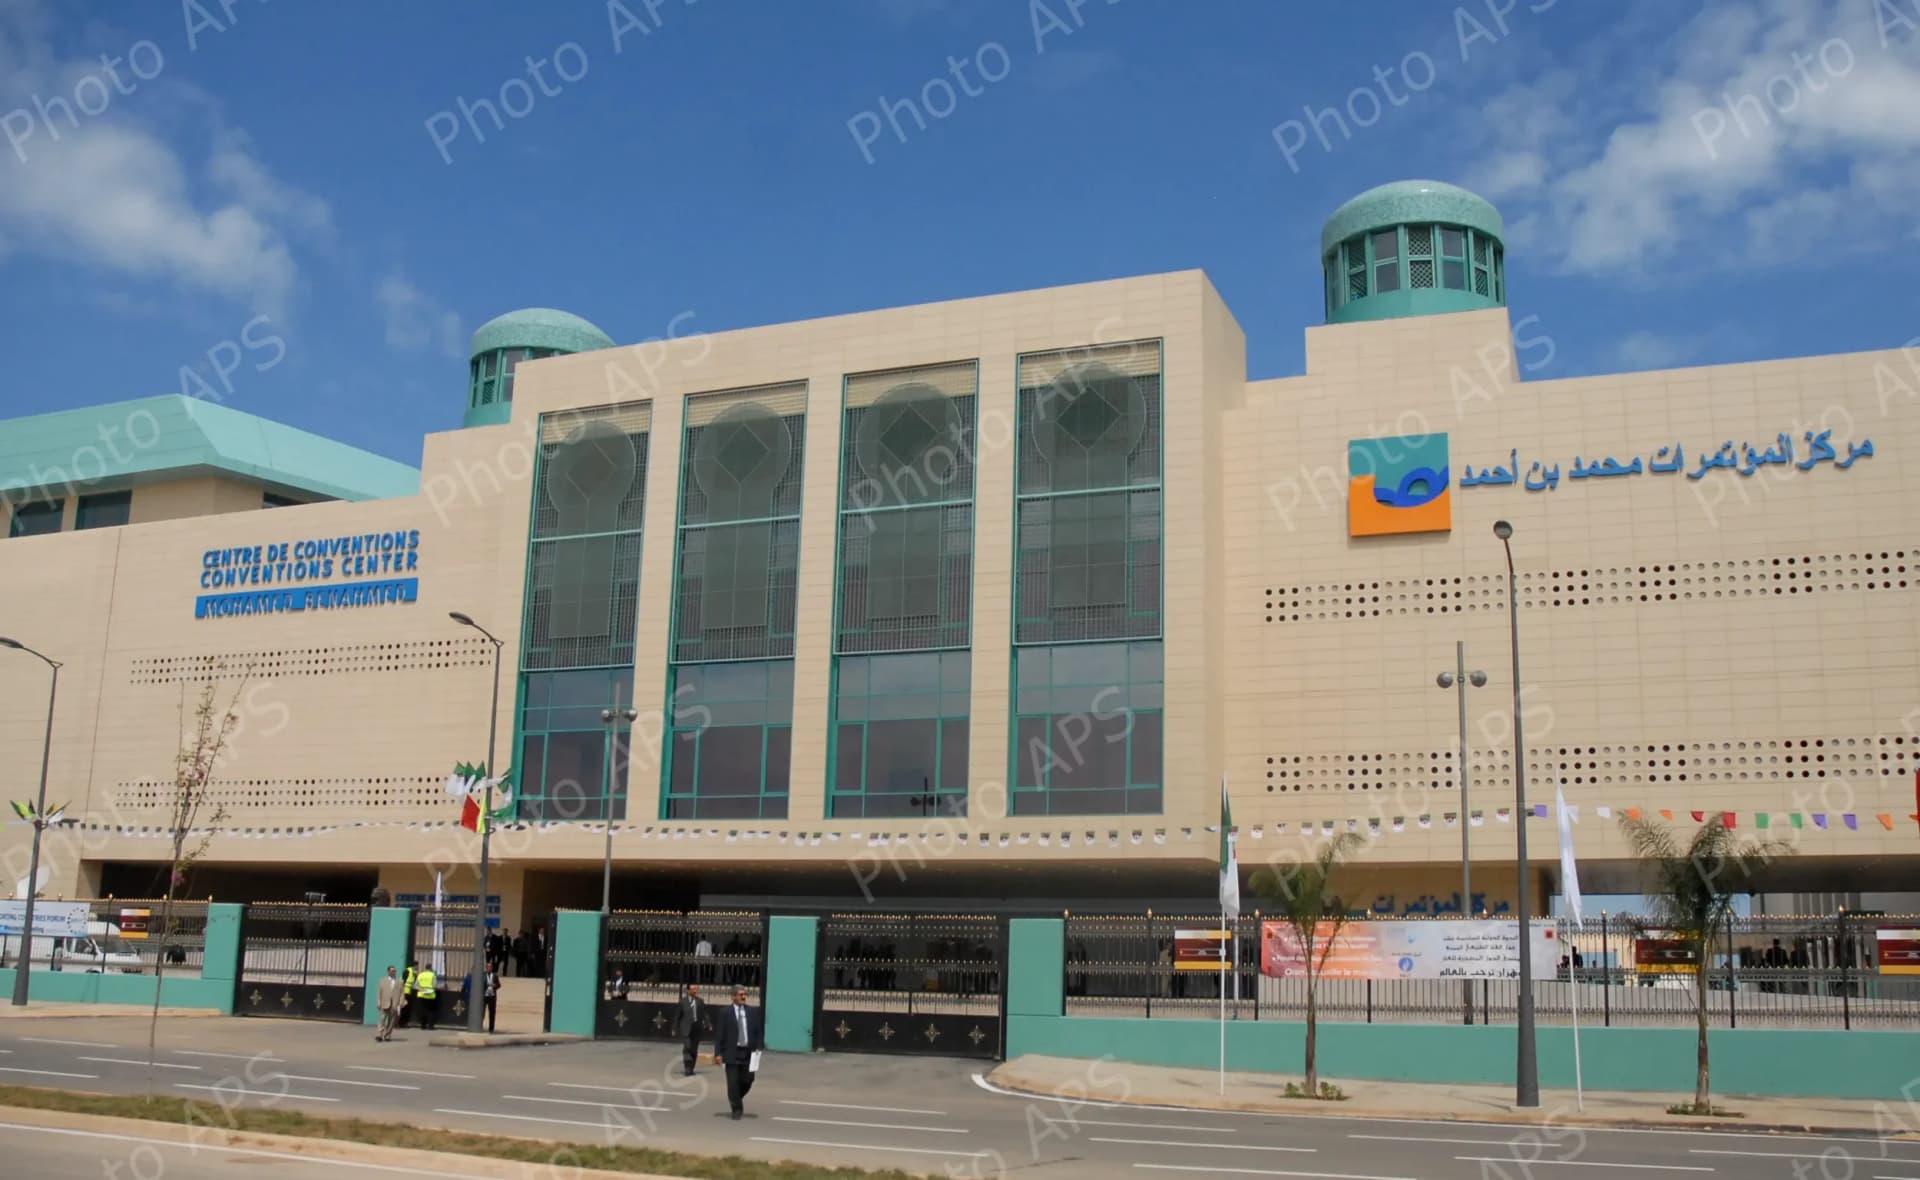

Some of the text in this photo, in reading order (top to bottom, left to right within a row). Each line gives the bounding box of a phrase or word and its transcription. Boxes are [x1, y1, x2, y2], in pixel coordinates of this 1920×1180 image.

[1459, 428, 1875, 490] مركز المؤتمرات محمد بن أحمد
[202, 529, 420, 568] CENTRE DE CONVENTIONS
[200, 551, 418, 588] CONVENTIONS CENTER
[203, 592, 294, 618] MOHAMED
